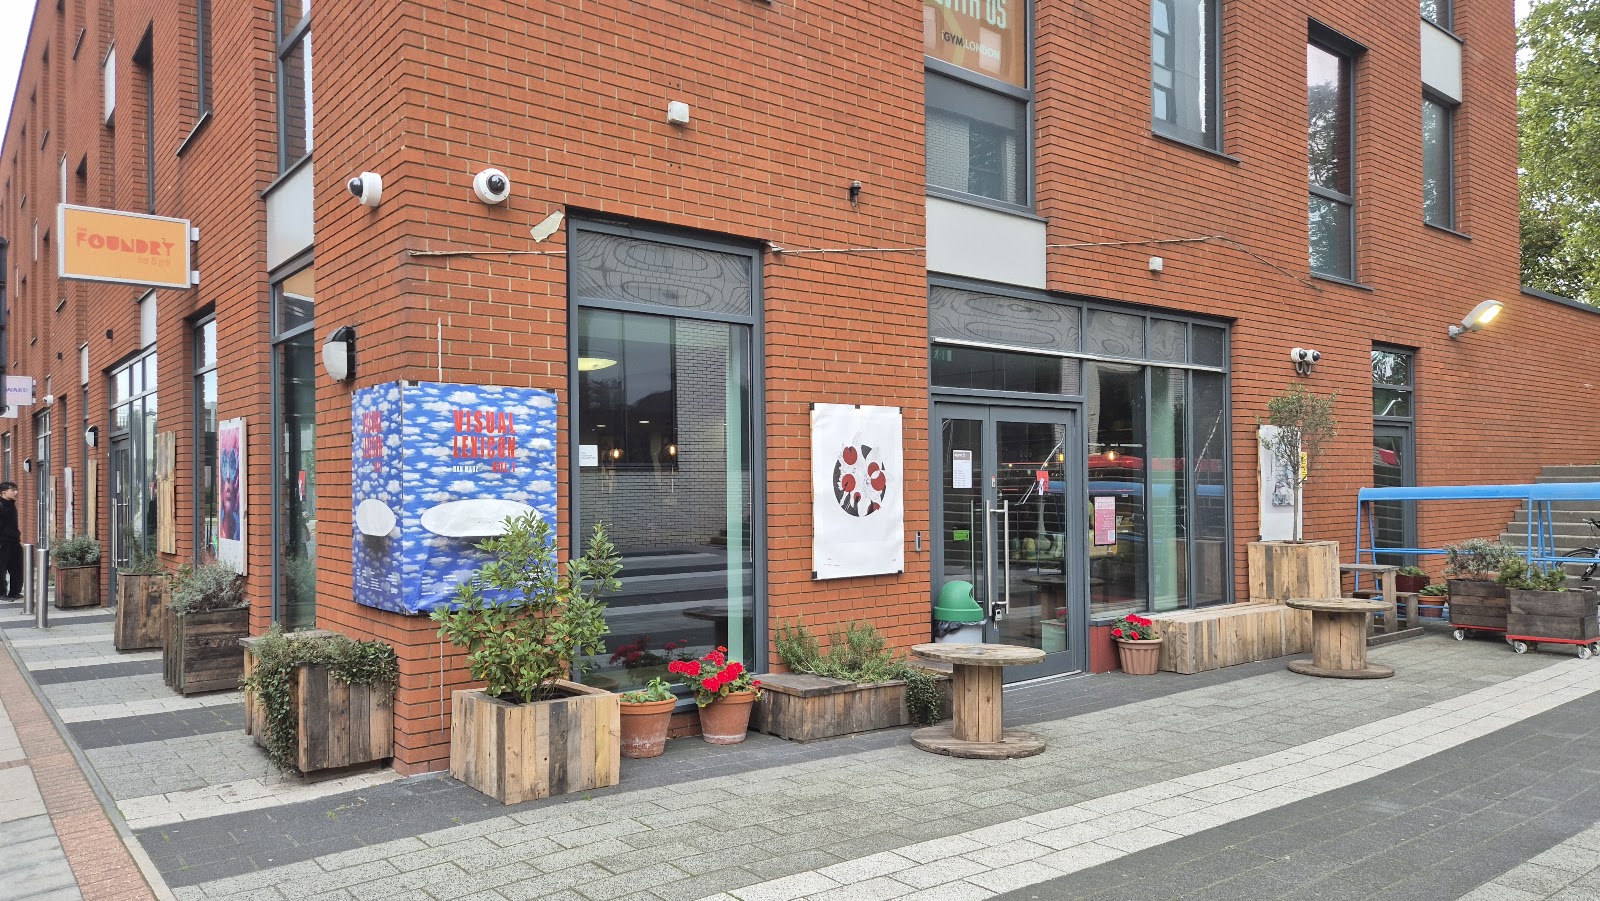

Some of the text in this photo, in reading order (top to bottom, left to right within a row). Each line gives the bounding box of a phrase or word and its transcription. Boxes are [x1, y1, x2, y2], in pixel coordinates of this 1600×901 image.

[77, 231, 175, 256] FOUNDRY
[453, 409, 516, 434] VISUAL
[453, 435, 516, 459] LEXICON
